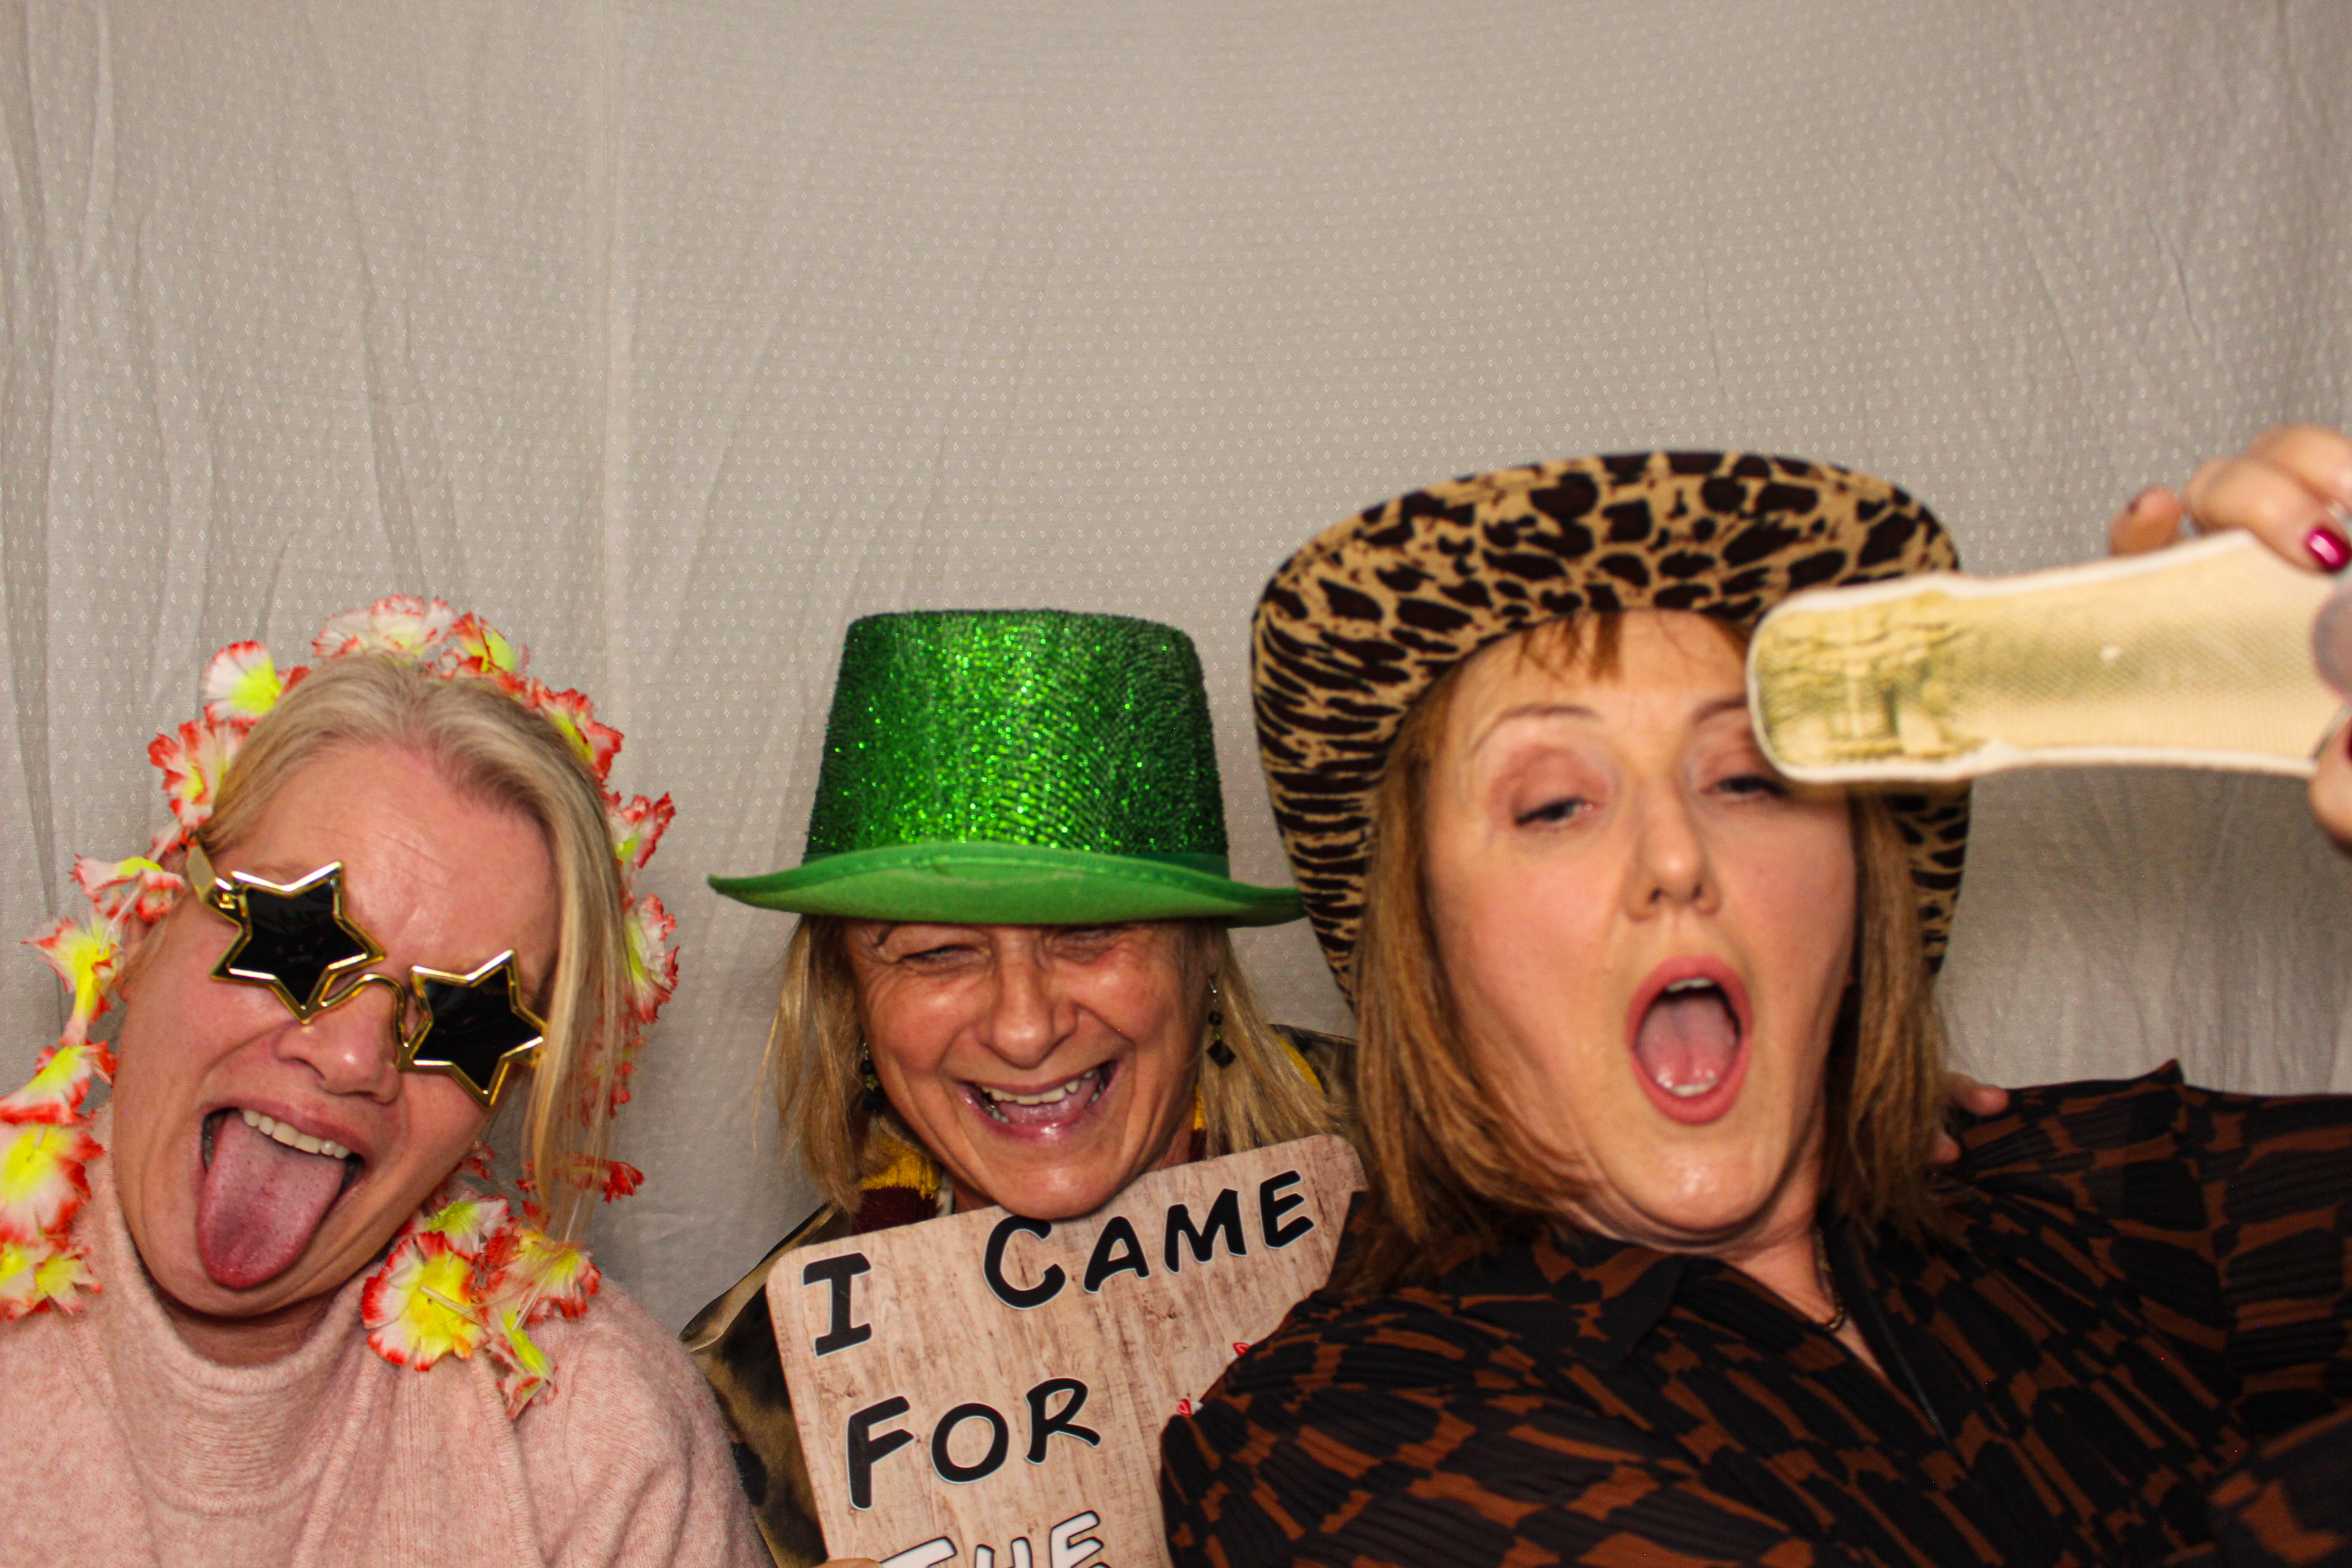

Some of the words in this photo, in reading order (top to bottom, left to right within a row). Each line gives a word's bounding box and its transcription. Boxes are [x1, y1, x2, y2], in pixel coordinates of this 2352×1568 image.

[803, 1253, 871, 1357] I
[984, 1170, 1315, 1309] CAME
[847, 1378, 1101, 1509] FOR
